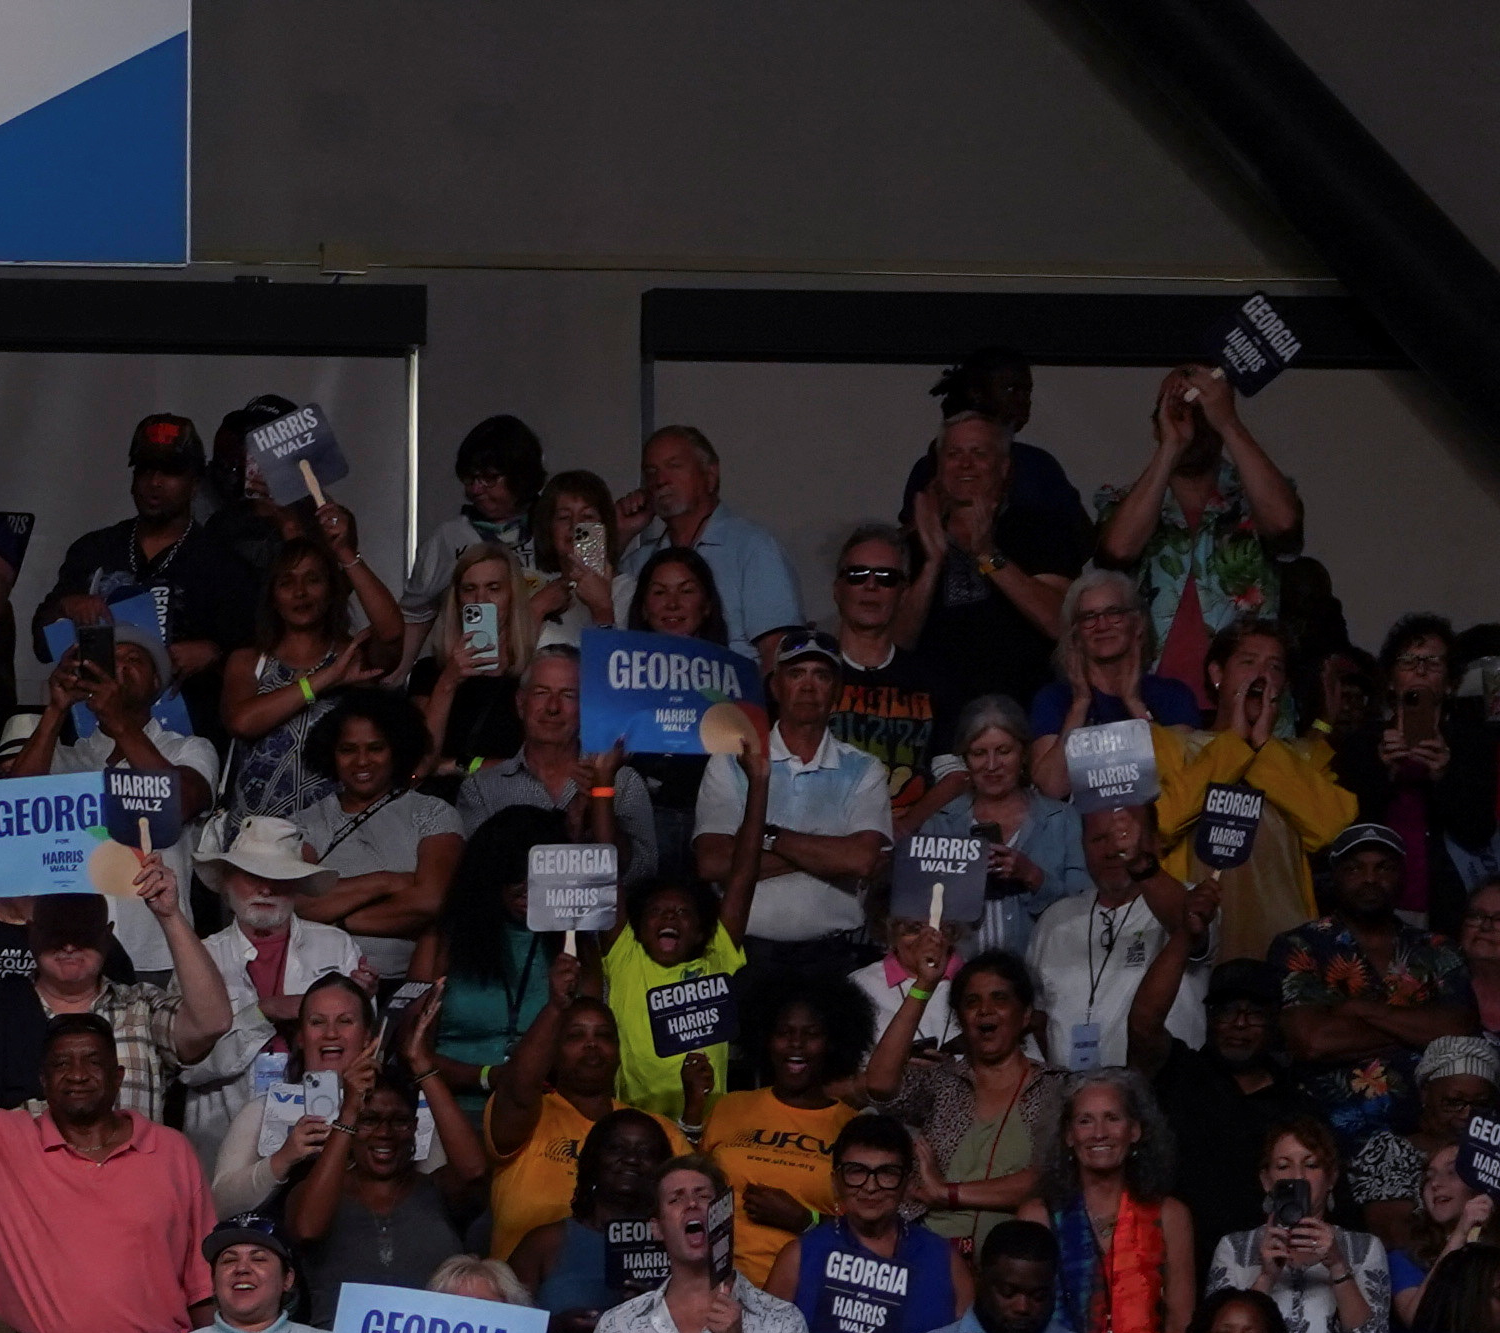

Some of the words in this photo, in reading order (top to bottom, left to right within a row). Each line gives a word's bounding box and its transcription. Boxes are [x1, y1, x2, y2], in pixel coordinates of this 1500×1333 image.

[1241, 295, 1302, 367] GEORGIA
[1221, 344, 1251, 376] WALZ
[1224, 327, 1267, 373] HARRIS
[254, 408, 319, 453] HARRIS
[272, 432, 317, 459] WALZ
[608, 650, 742, 698] GEORGIA
[655, 708, 697, 725] HARRIS
[1206, 788, 1260, 821] GEORGIA
[531, 848, 613, 874] GEORGIA
[909, 837, 982, 860] HARRIS
[920, 859, 967, 875] WALZ
[545, 888, 599, 907] HARRIS
[825, 1252, 908, 1297] GEORGIA
[832, 1297, 886, 1328] HARRIS
